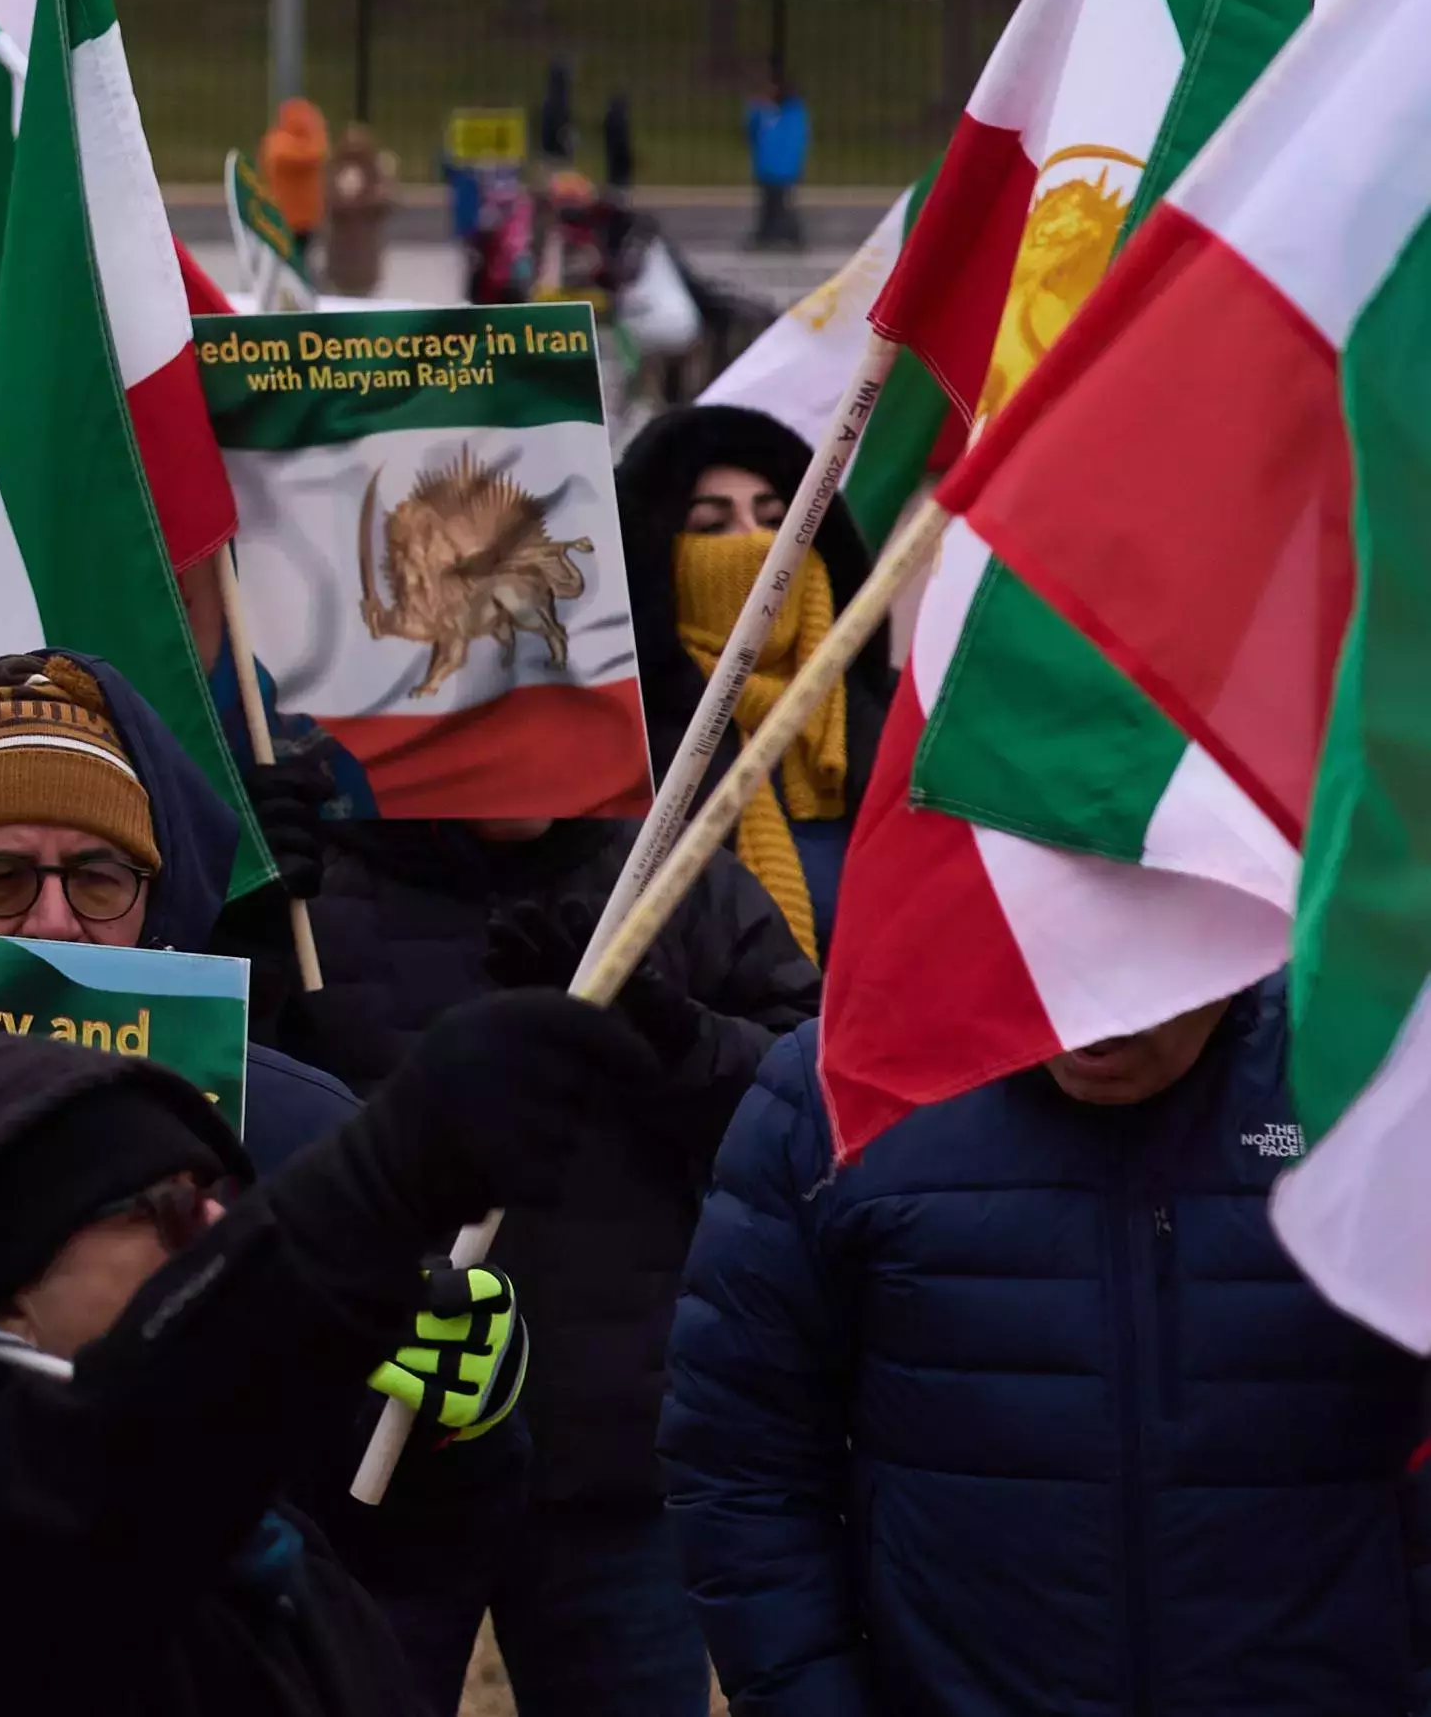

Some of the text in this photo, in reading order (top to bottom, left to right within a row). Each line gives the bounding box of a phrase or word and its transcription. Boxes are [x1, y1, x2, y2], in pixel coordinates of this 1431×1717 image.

[196, 324, 588, 365] edom Democracy in Iran
[247, 360, 494, 395] with Maryam Rajavi
[50, 1008, 150, 1057] and
[1240, 1134, 1298, 1145] NORTH
[1264, 1123, 1297, 1135] THE
[1258, 1145, 1299, 1157] FACE
